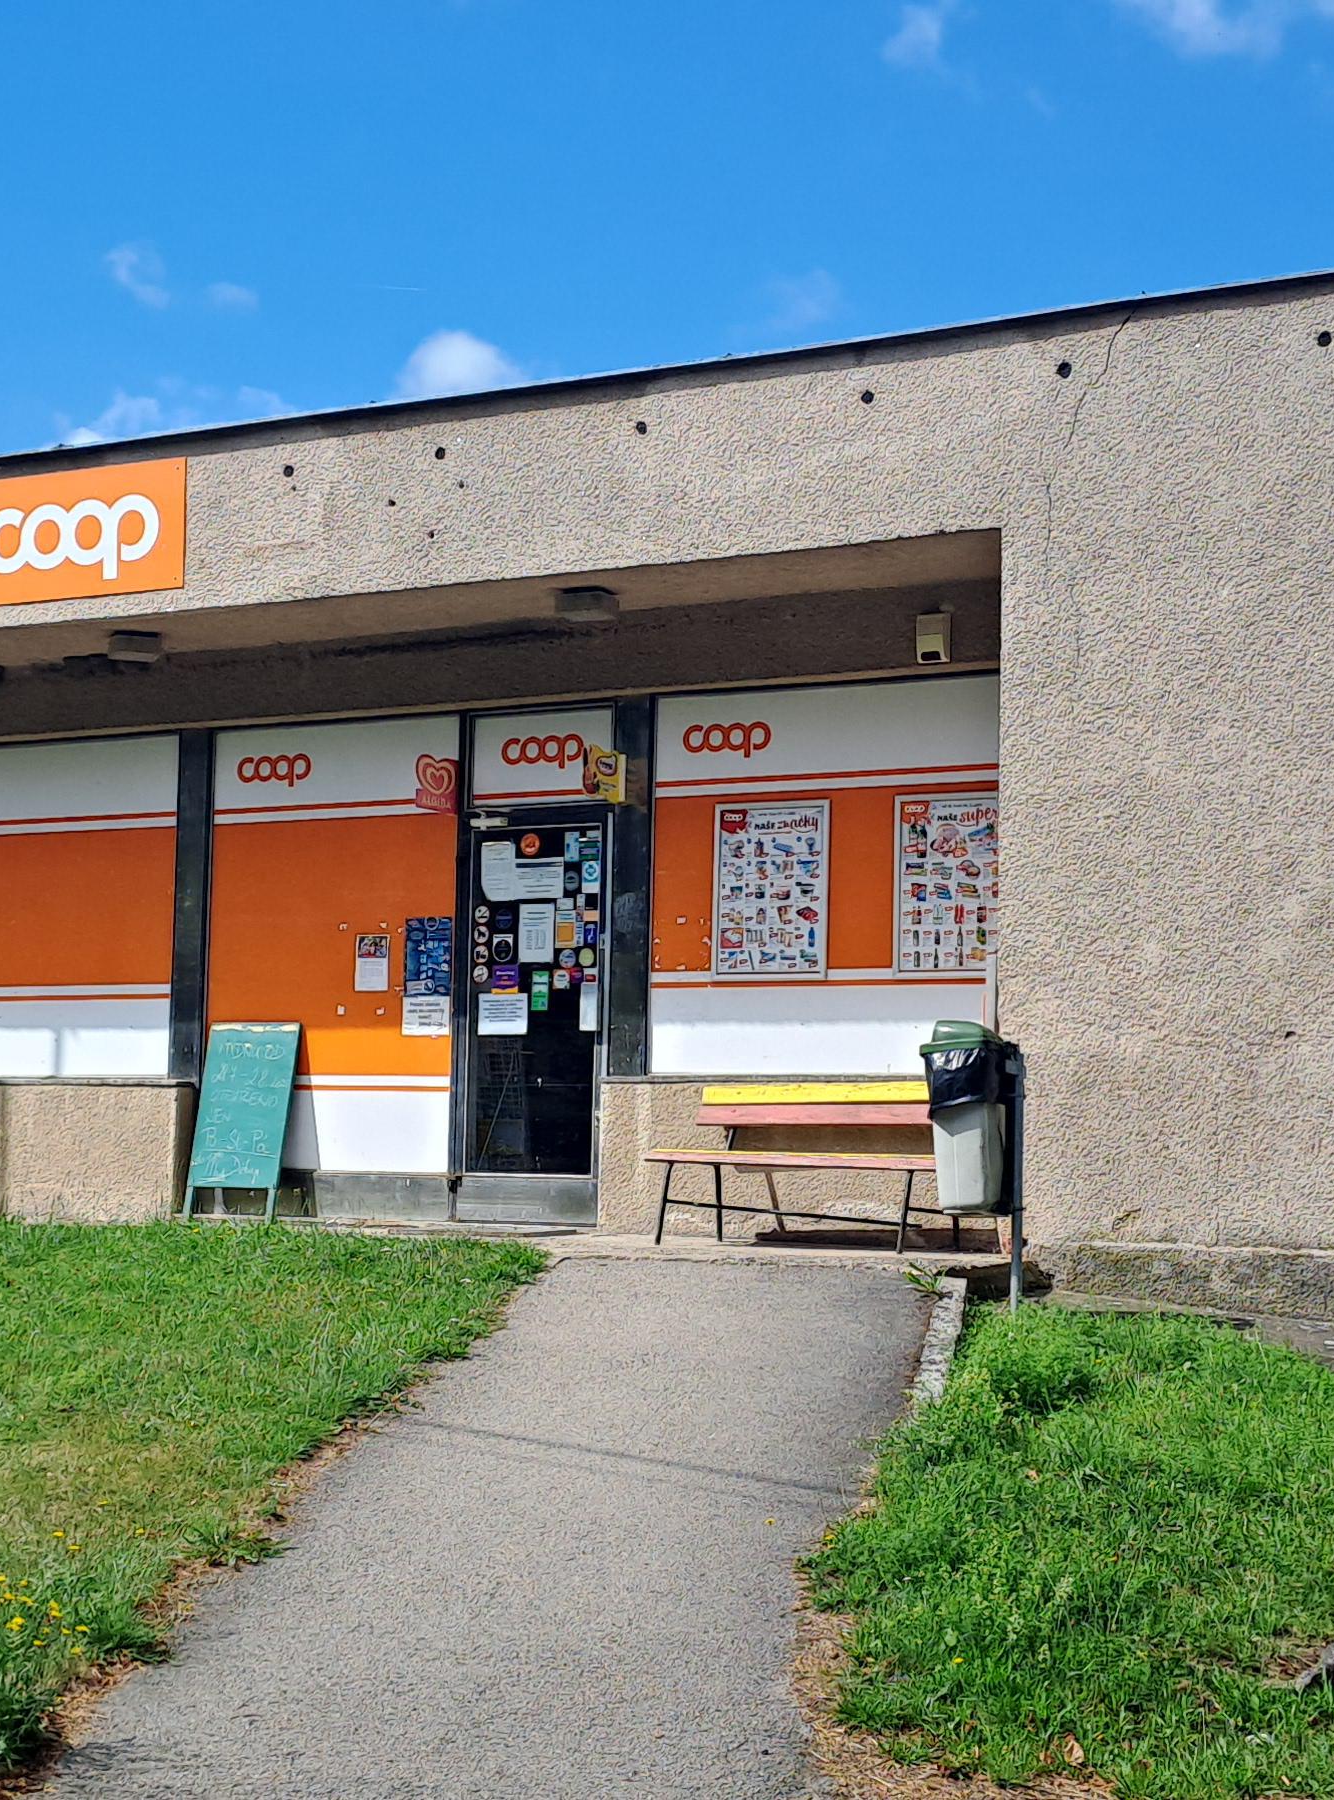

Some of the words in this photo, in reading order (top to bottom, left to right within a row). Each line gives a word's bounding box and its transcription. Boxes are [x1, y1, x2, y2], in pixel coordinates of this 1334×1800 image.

[501, 733, 584, 769] coop
[683, 721, 772, 758] coop
[237, 753, 312, 787] coop
